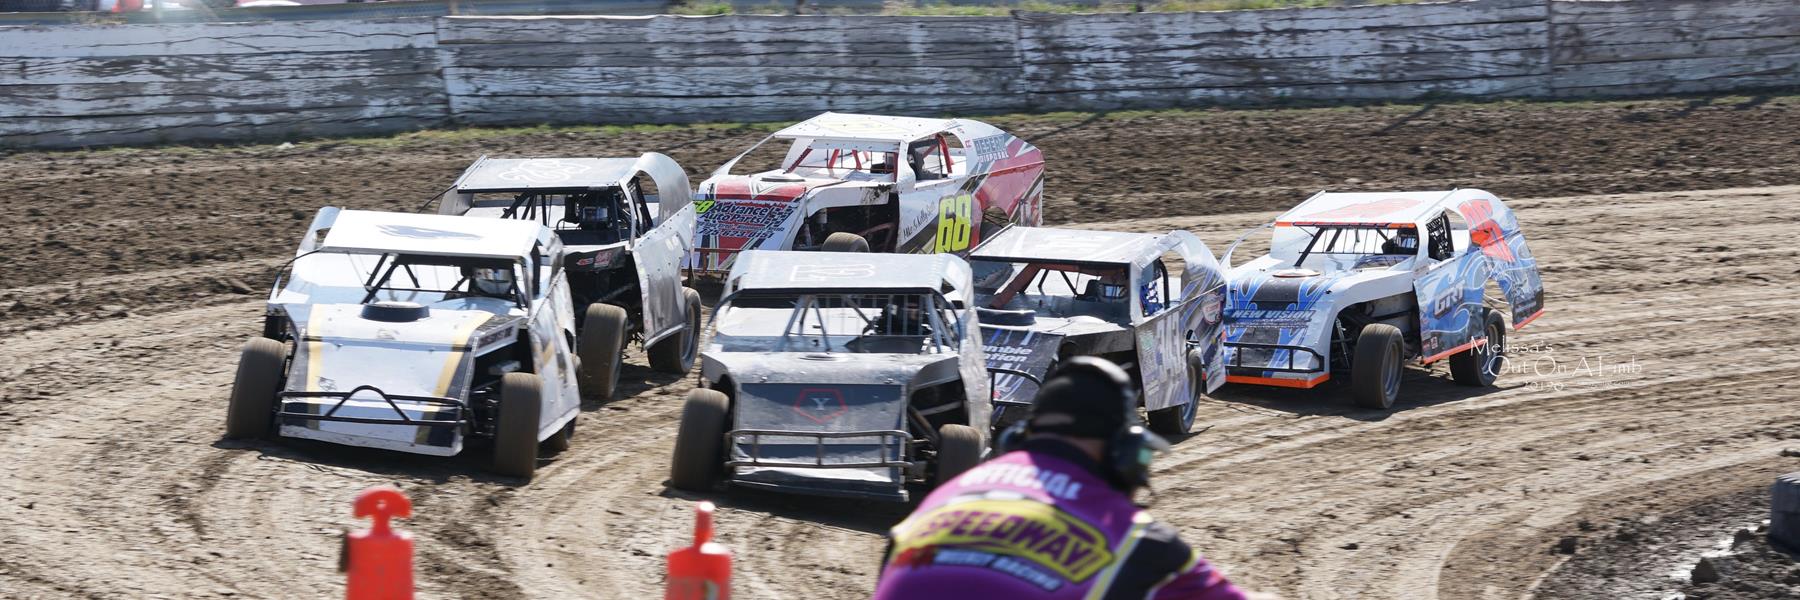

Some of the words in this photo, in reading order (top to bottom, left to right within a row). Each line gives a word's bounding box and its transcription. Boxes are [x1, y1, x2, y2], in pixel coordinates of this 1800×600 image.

[709, 204, 767, 216] Advance
[700, 211, 732, 222] Auto
[731, 213, 766, 224] Parts
[935, 194, 973, 254] 68
[1433, 282, 1465, 317] GRT
[1232, 309, 1265, 319] NEW
[1264, 309, 1315, 320] VISION
